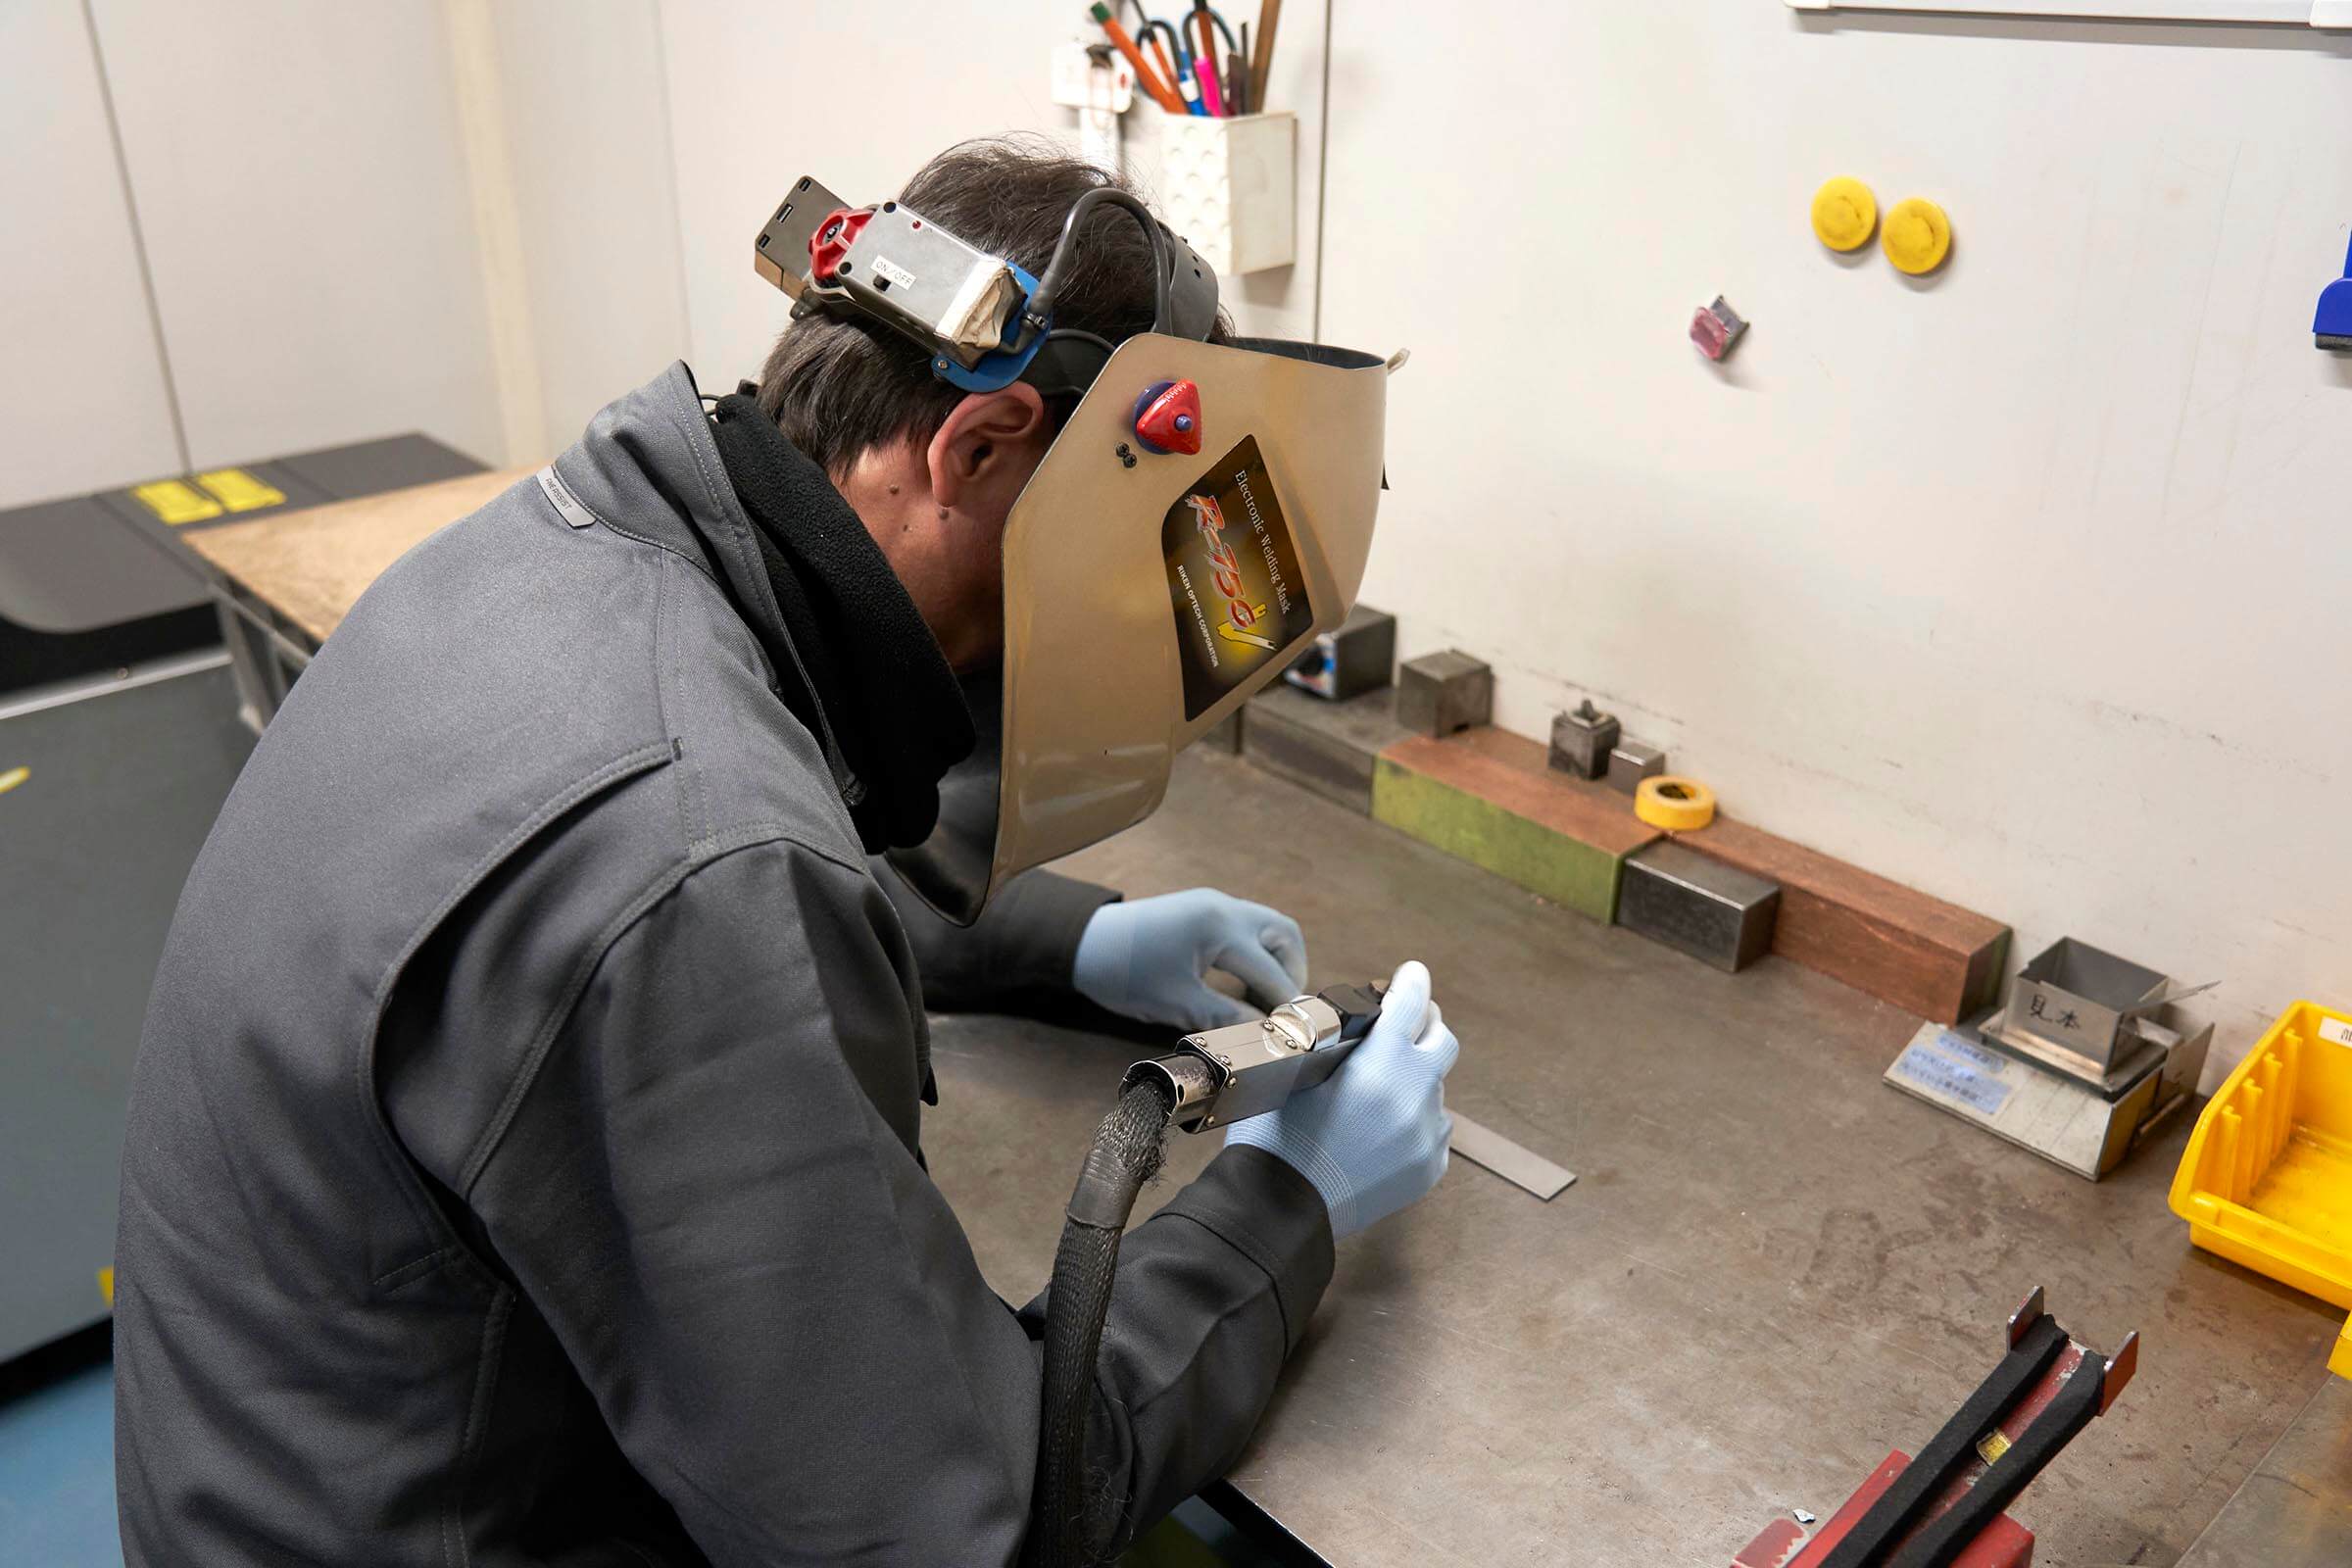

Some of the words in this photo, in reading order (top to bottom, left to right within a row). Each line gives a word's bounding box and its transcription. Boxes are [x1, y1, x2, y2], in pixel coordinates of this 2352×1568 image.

[876, 261, 912, 284] ON/OFF
[1235, 469, 1264, 535] Electronic
[1260, 534, 1281, 584] Welding
[1276, 582, 1292, 614] Mask
[1177, 564, 1191, 590] RIKEN
[1188, 590, 1202, 619] OPTECH
[1199, 619, 1219, 667] CORPORATION
[2029, 993, 2081, 1030] 見本
